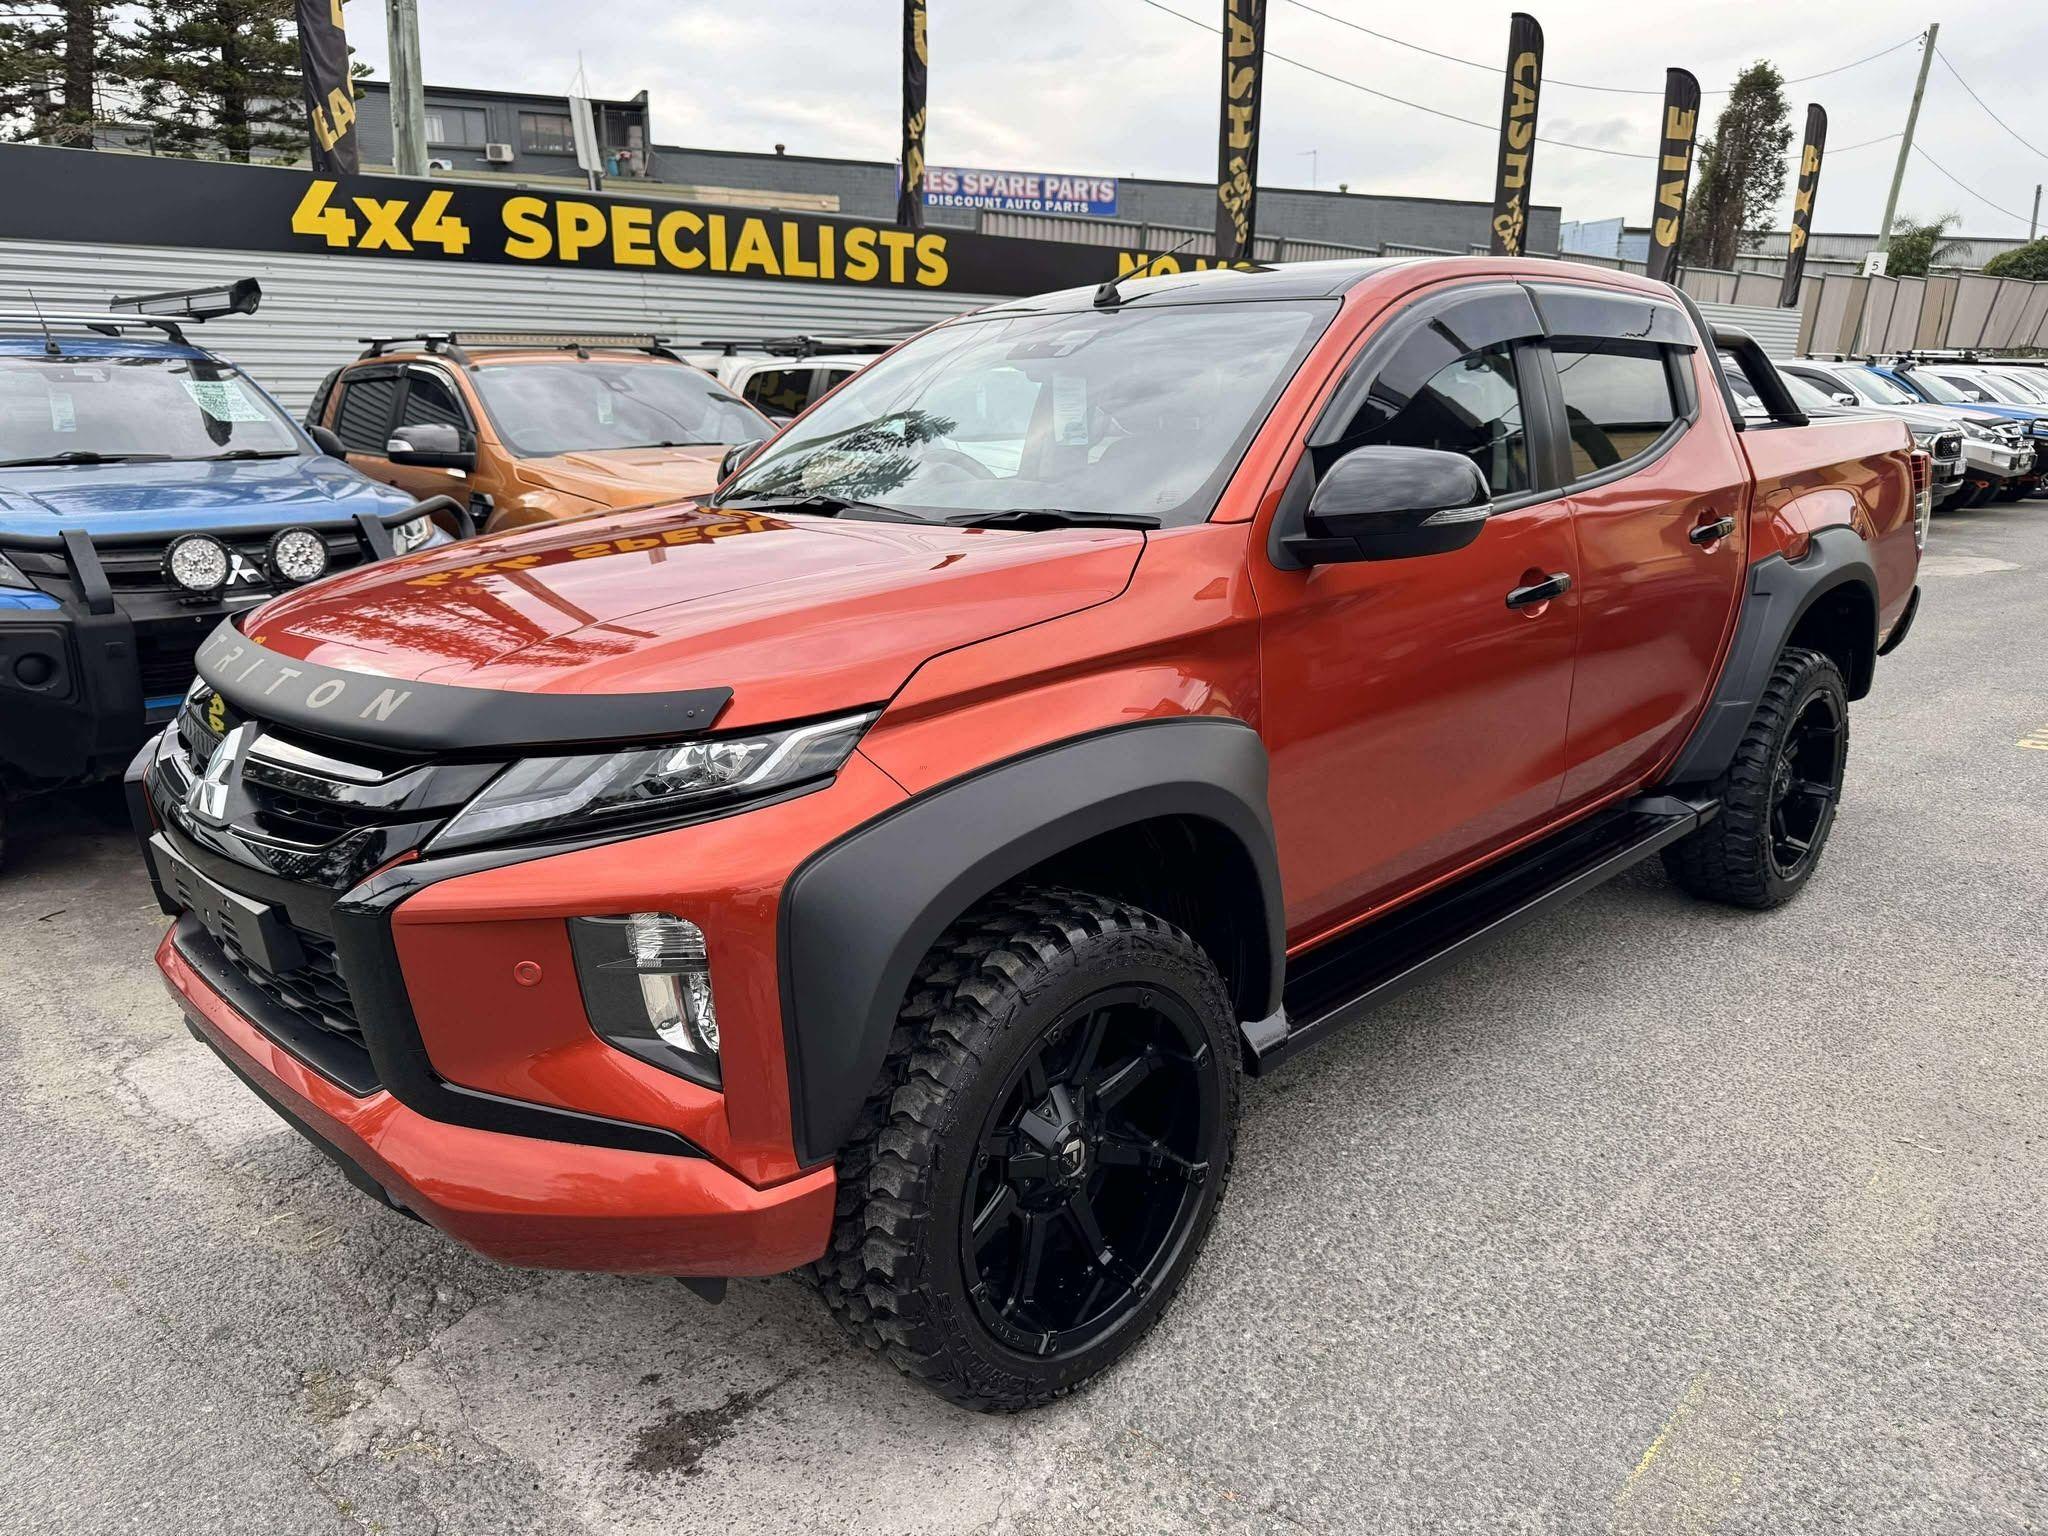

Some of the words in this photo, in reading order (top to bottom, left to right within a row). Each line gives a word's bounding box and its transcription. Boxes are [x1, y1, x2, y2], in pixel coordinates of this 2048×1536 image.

[962, 172, 1040, 198] SPARE
[1045, 178, 1115, 203] PARTS
[928, 194, 1002, 210] DISCOUNT
[1005, 199, 1042, 211] AUTO
[1046, 202, 1090, 213] PARTS
[502, 196, 949, 287] SPECIALISTS
[1871, 260, 1880, 271] 5
[201, 633, 412, 721] TRITON
